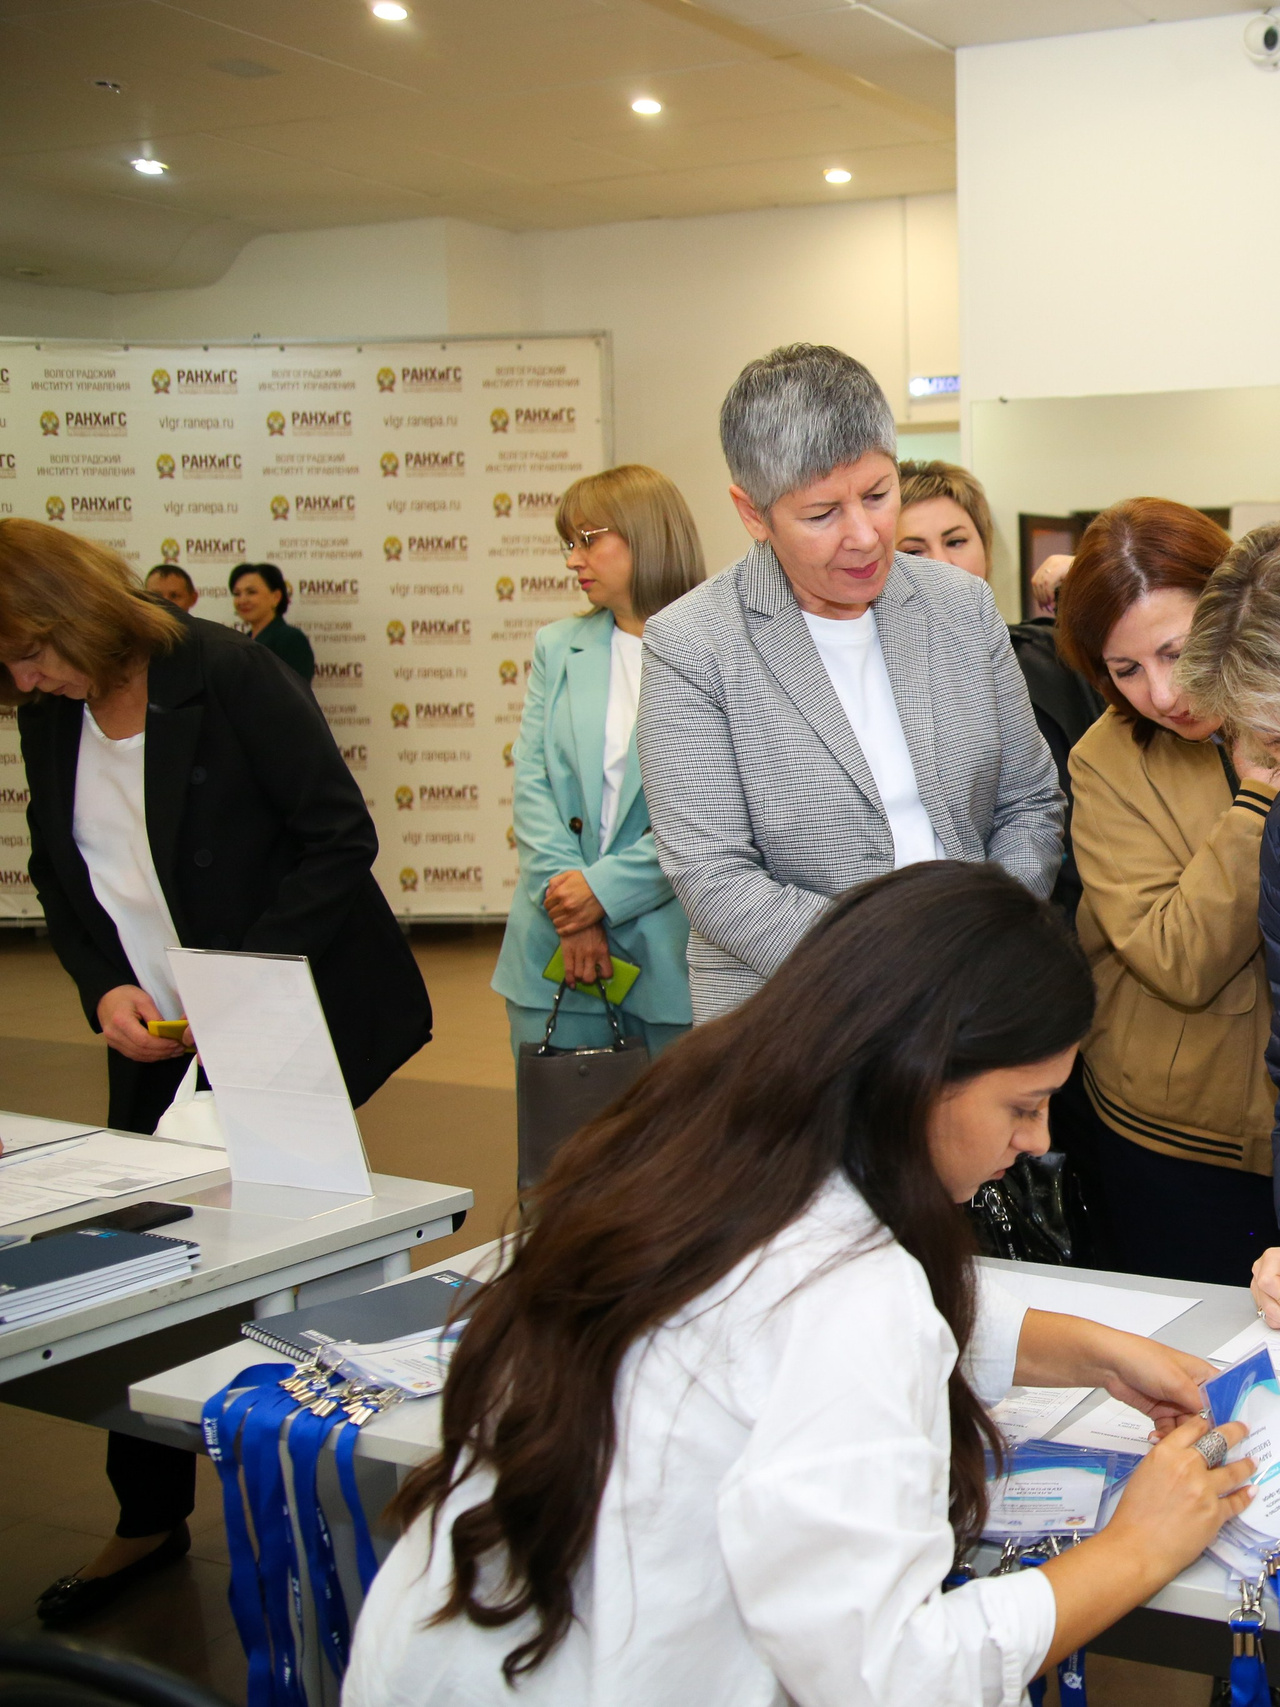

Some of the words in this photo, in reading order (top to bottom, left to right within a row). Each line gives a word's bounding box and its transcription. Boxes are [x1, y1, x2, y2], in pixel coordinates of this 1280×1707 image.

[177, 369, 238, 383] РАНХиГС
[402, 367, 462, 382] РАНХиГС
[65, 412, 127, 426] РАНХиГС
[291, 411, 352, 426] РАНХиГС
[383, 414, 458, 429] vlgr.ranepa.ru
[515, 408, 576, 422] РАНХиГС
[159, 417, 234, 431] vlgr.ranepa.ru
[181, 454, 242, 469] РАНХиГС
[405, 452, 465, 466] РАНХиГС
[71, 497, 132, 511] РАНХиГС
[295, 496, 355, 510] РАНХиГС
[387, 499, 461, 513] vlgr.ranepa.ru
[518, 493, 560, 506] РАНХи
[164, 502, 238, 515] vlgr.ranepa.ru
[186, 539, 246, 553] РАНХиГС
[408, 536, 468, 551] РАНХиГС
[299, 579, 358, 594] РАНХиГС
[389, 583, 463, 597] vlgr.ranepa.ru
[411, 620, 470, 634] РАНХиГС
[315, 664, 362, 678] АНХиГС
[393, 667, 467, 680] vlgr.ranepa.ru
[415, 703, 475, 718] РАНХиГС
[398, 750, 470, 763] vlgr.ranepa.ru
[419, 786, 478, 800] РАНХиГС
[402, 832, 475, 845] vlgr.ranepa.ru
[423, 868, 483, 882] РАНХиГС
